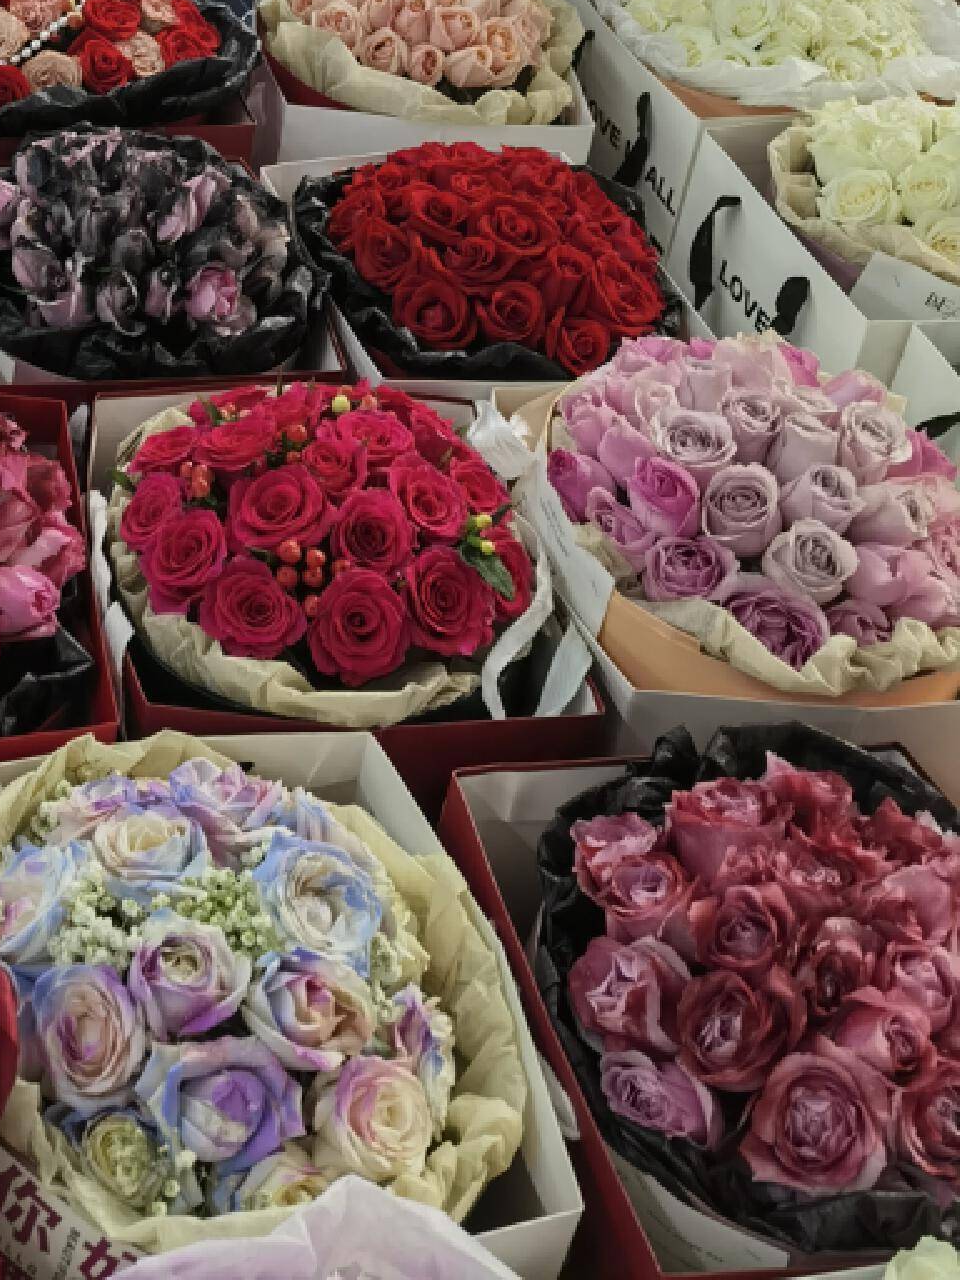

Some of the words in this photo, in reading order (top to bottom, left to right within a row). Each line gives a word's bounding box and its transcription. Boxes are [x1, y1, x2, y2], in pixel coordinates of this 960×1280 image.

[590, 99, 621, 149] OVE
[645, 166, 675, 216] ALL
[720, 259, 770, 335] LOVE
